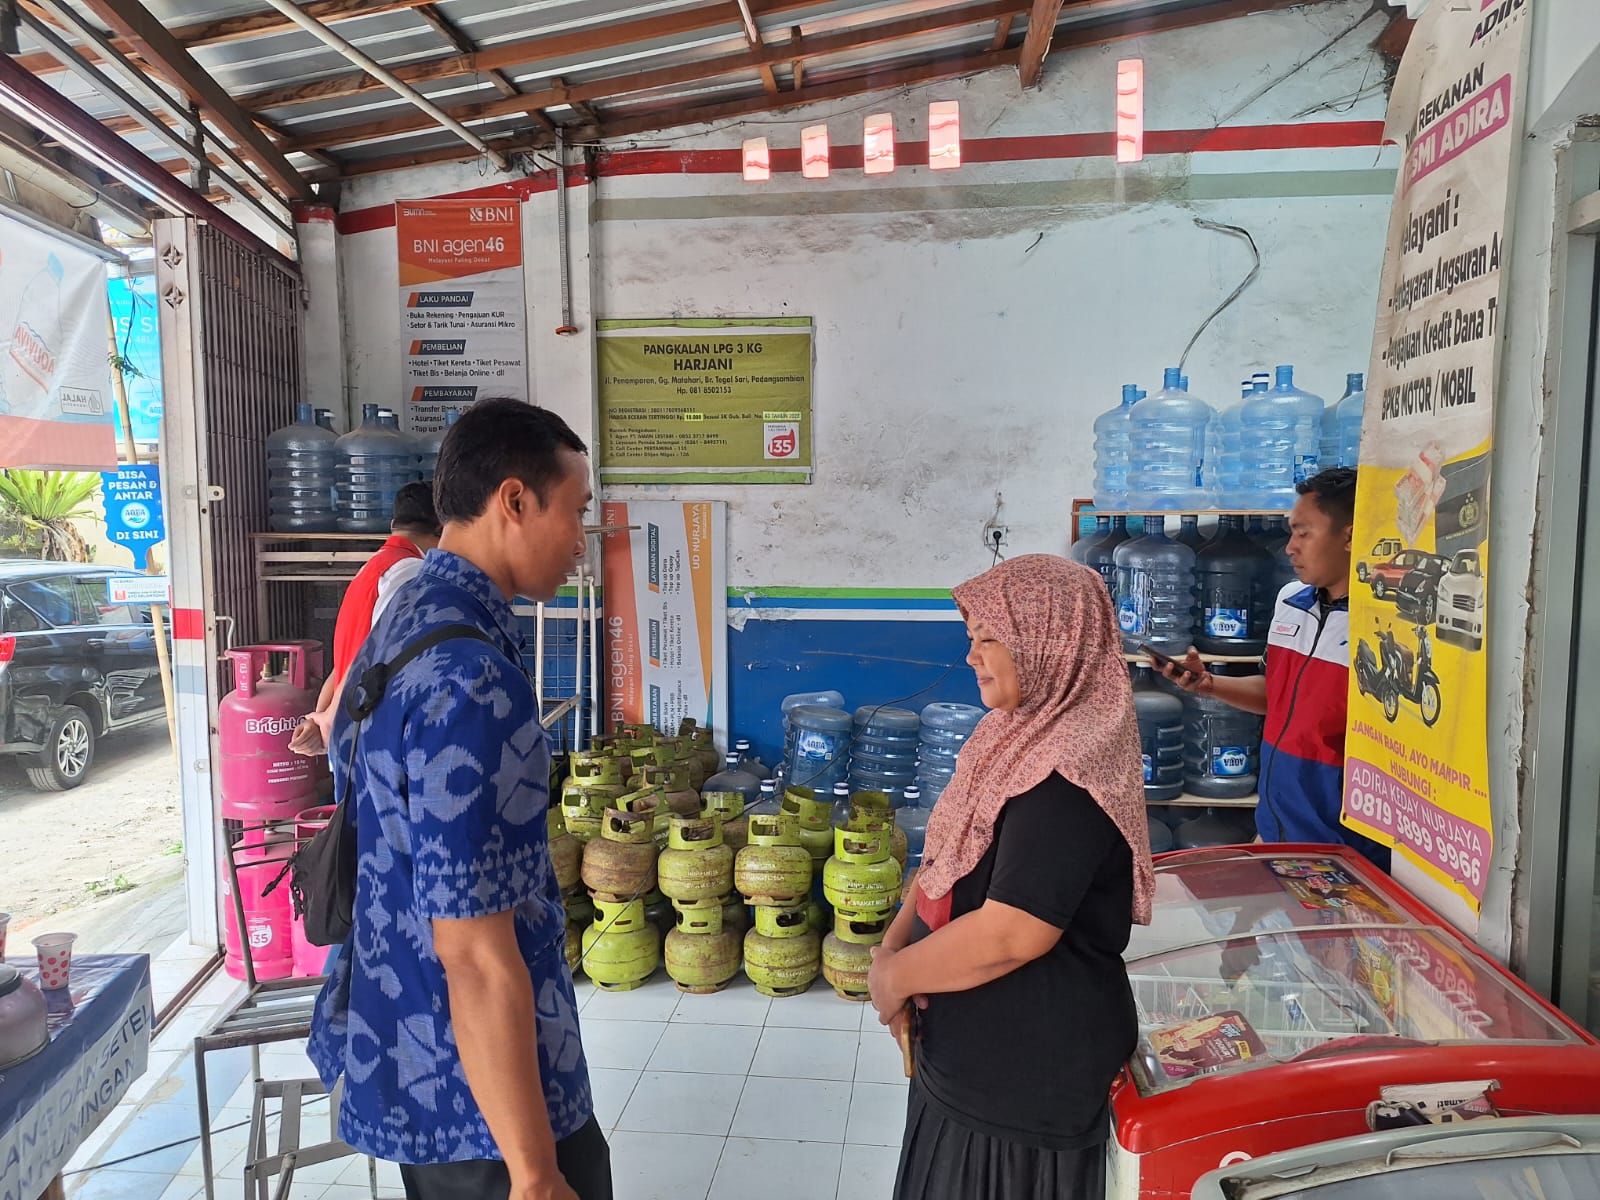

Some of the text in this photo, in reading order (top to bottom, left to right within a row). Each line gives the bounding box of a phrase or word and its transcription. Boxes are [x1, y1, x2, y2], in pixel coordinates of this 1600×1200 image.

[1419, 62, 1484, 132] REKANAN
[1439, 87, 1504, 158] ADIRA
[486, 207, 513, 221] BNI
[1401, 188, 1451, 254] elayani
[414, 237, 504, 256] BNI agen46
[1435, 244, 1486, 295] Angsuran
[1490, 232, 1503, 272] A
[1422, 311, 1452, 354] Kredit
[1454, 308, 1484, 346] Dana
[1488, 297, 1497, 336] T
[644, 343, 763, 355] PANGKALAN LPG 3 KG
[674, 359, 732, 370] HARJANI
[658, 377, 669, 385] Gg.
[672, 377, 702, 385] Matahari,
[734, 376, 750, 384] Sari,
[1381, 384, 1400, 421] BPKB
[1401, 376, 1431, 416] MOTOR
[1441, 366, 1476, 408] MOBIL
[769, 440, 792, 453] 135
[108, 481, 146, 490] PESAN
[118, 470, 146, 479] BISA
[114, 491, 153, 500] ANTAR
[116, 530, 159, 540] DI SINI
[692, 504, 700, 569] UD NURJAYA
[649, 554, 657, 583] LAYANAN
[1213, 622, 1237, 633] AQUA
[608, 616, 627, 723] BNI agen46
[246, 717, 296, 735] Bright
[1224, 757, 1244, 768] AQUA
[1352, 720, 1471, 792] JANGAN RAGU, AYO MAMPIR
[1390, 760, 1431, 798] HUBUNGI
[1352, 767, 1388, 798] ADIRA
[1390, 784, 1420, 818] KEDAY
[1351, 788, 1481, 886] 0819 3899 9966
